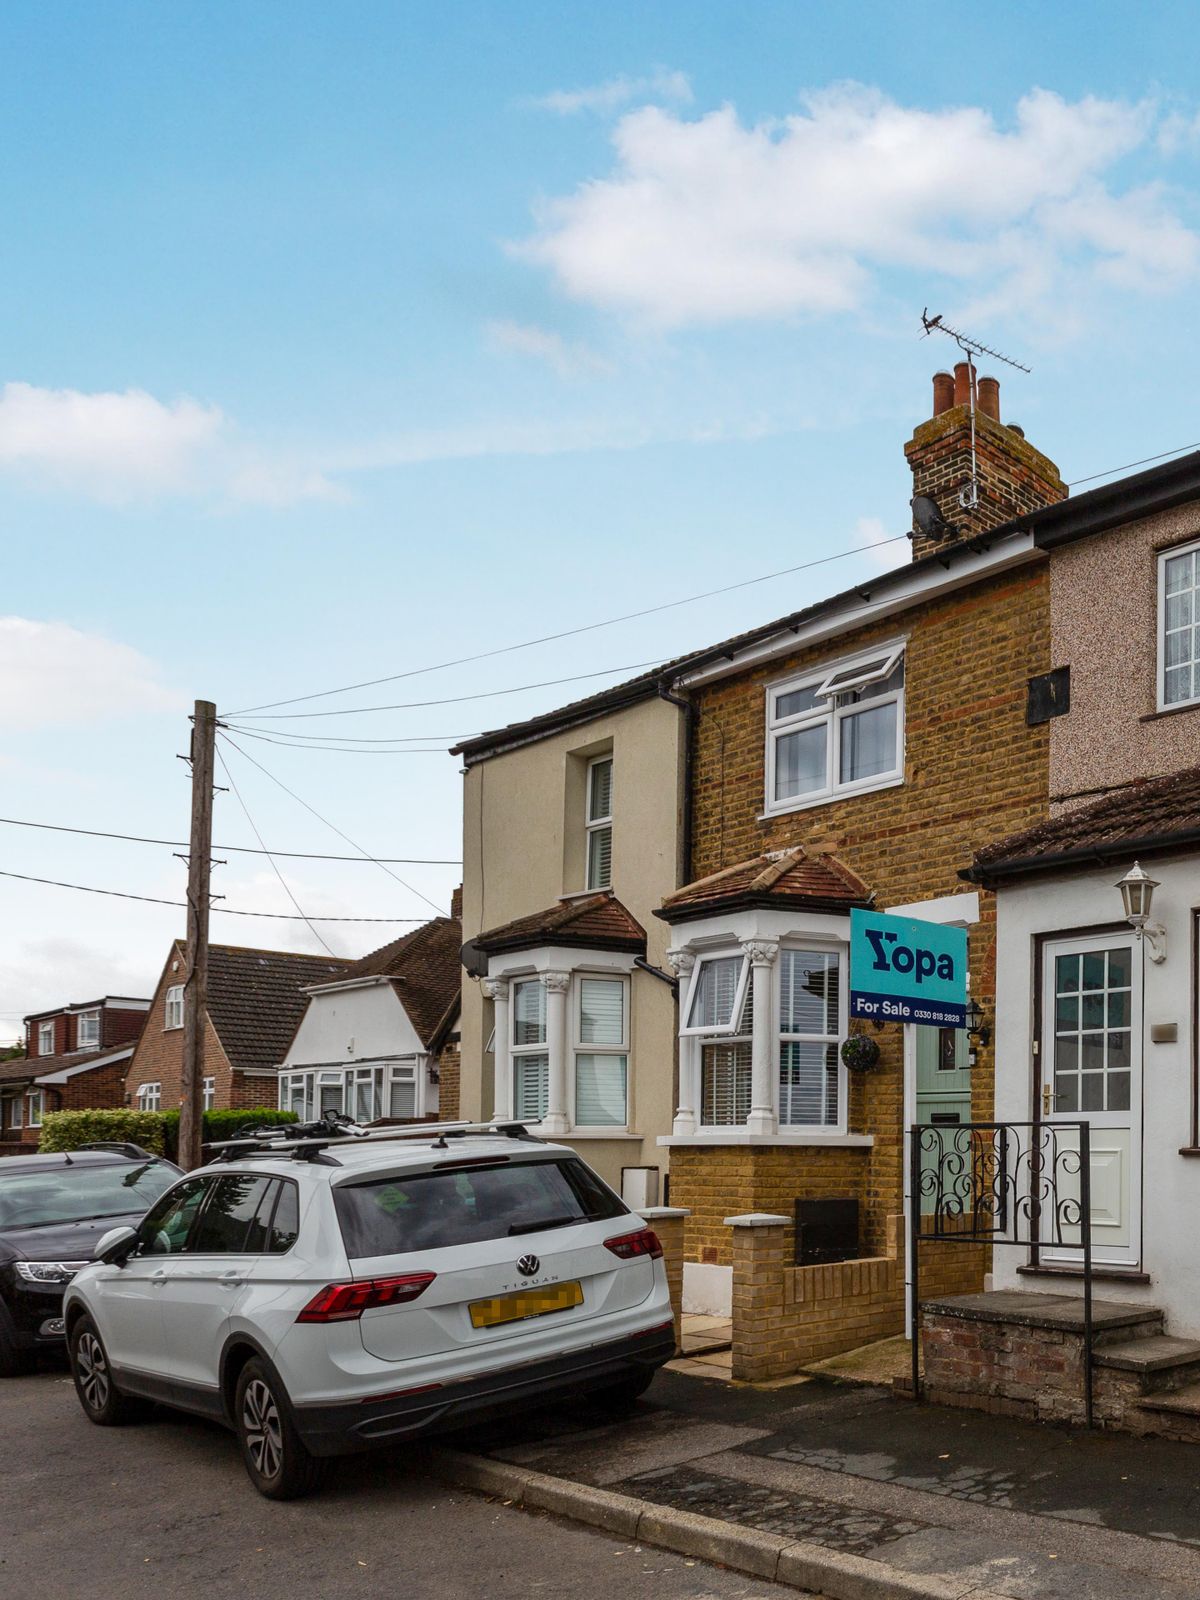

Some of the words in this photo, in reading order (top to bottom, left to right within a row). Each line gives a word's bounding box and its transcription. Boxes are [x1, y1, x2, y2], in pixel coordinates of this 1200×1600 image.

[865, 929, 953, 983] Yopa
[856, 998, 879, 1012] For
[882, 1000, 910, 1016] Sale
[914, 1010, 931, 1018] 0330
[932, 1012, 943, 1020] 818
[944, 1014, 960, 1022] 2828
[502, 1275, 558, 1290] TIGUAN
